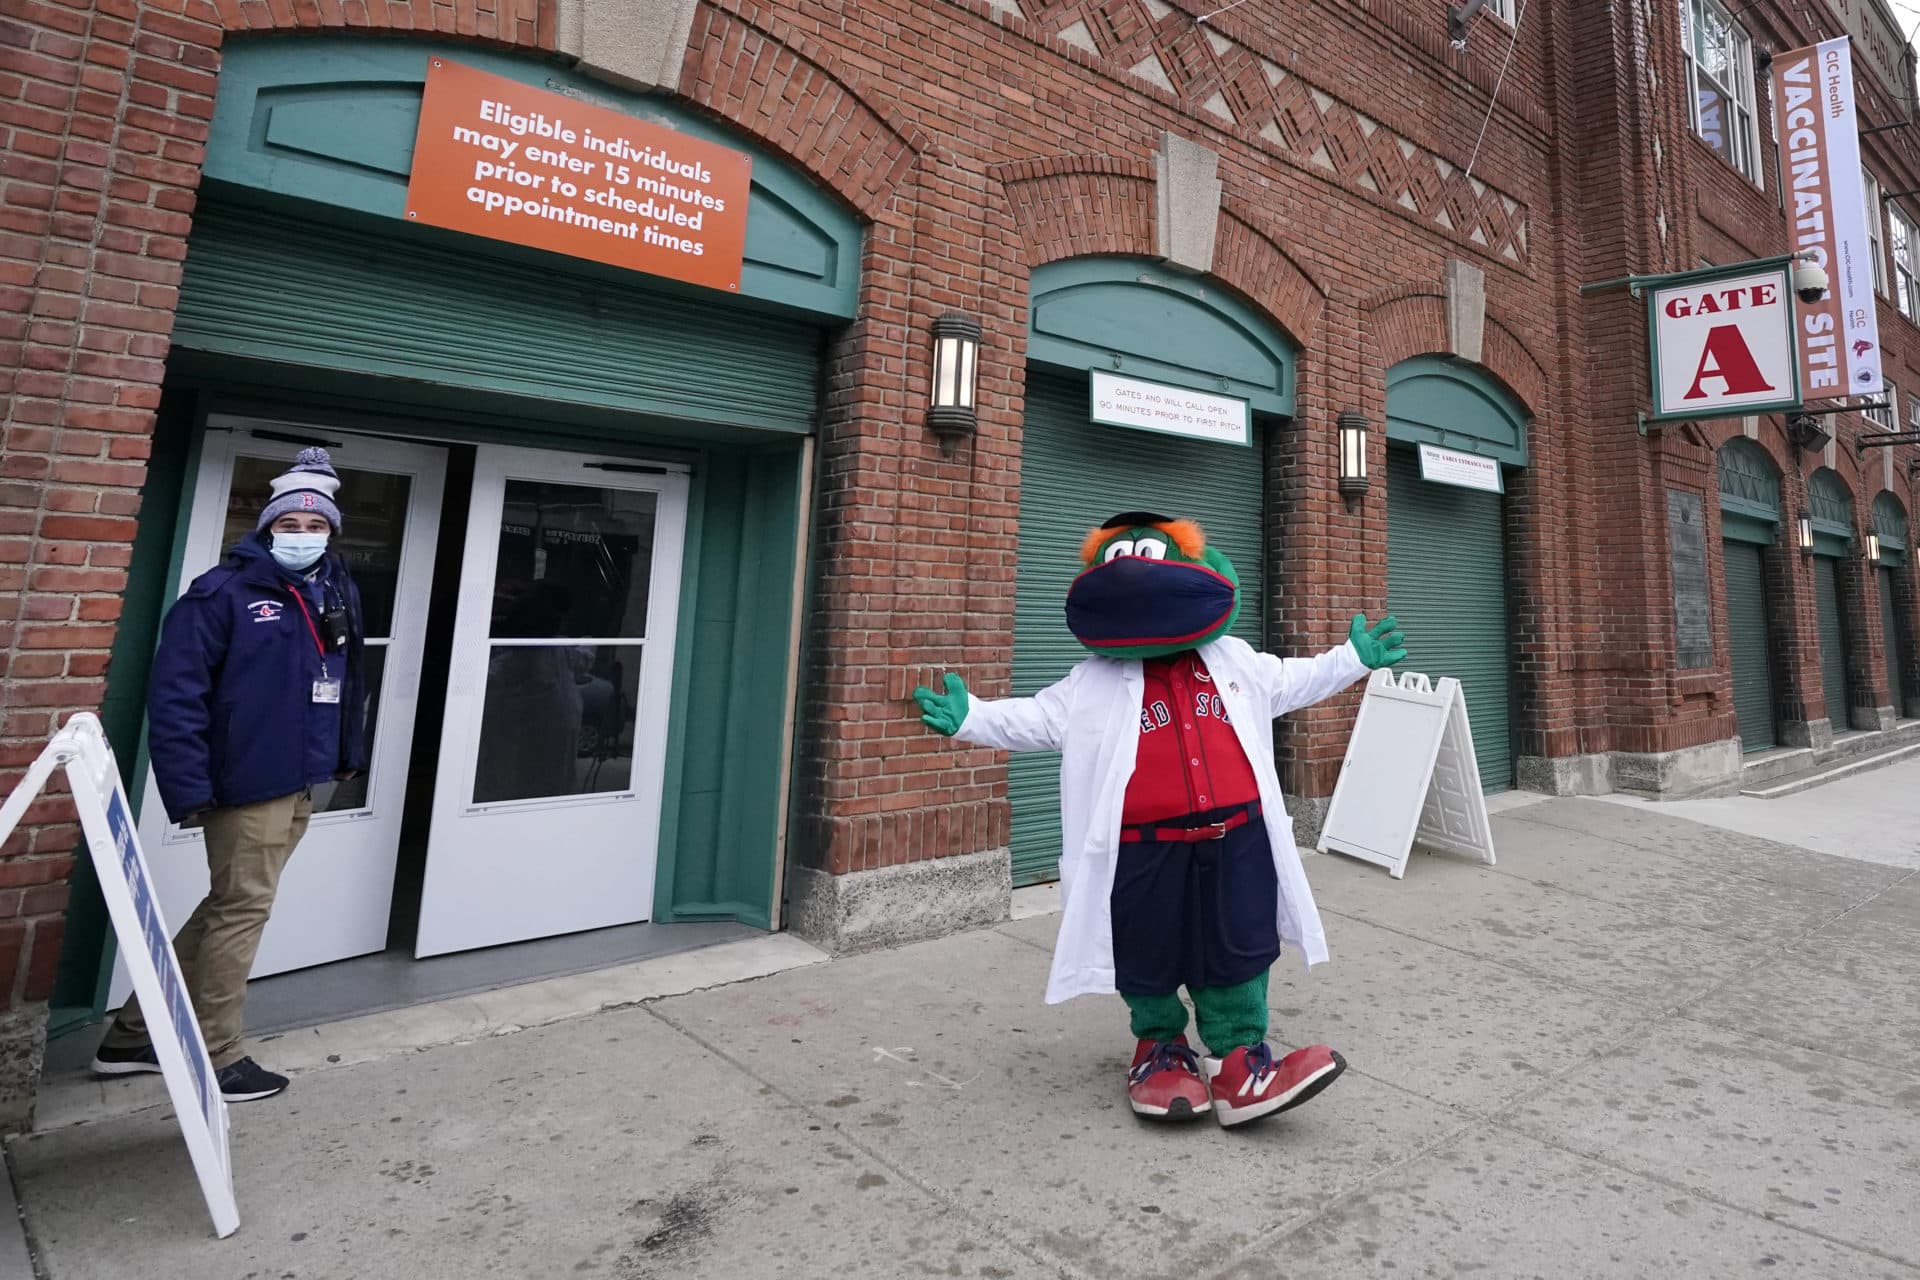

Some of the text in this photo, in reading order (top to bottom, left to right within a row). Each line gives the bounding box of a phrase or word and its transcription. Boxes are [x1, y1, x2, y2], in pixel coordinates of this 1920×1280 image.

[1826, 51, 1844, 118] CIC Health
[453, 126, 725, 212] may enter 15 minutes
[480, 99, 711, 183] Eligible individuals
[466, 187, 704, 256] appointment times
[475, 160, 703, 231] prior to scheduled
[1784, 57, 1839, 389] VACCINATI SITE
[1665, 284, 1776, 318] GATE
[1856, 309, 1866, 328] CIC
[1683, 324, 1775, 399] A
[1099, 400, 1241, 431] 90 MINUTES PRIOR TO FIRST PITCH
[1115, 388, 1228, 415] GATES AND WILL CALL OPEN
[302, 494, 314, 507] B
[1140, 700, 1170, 733] ED
